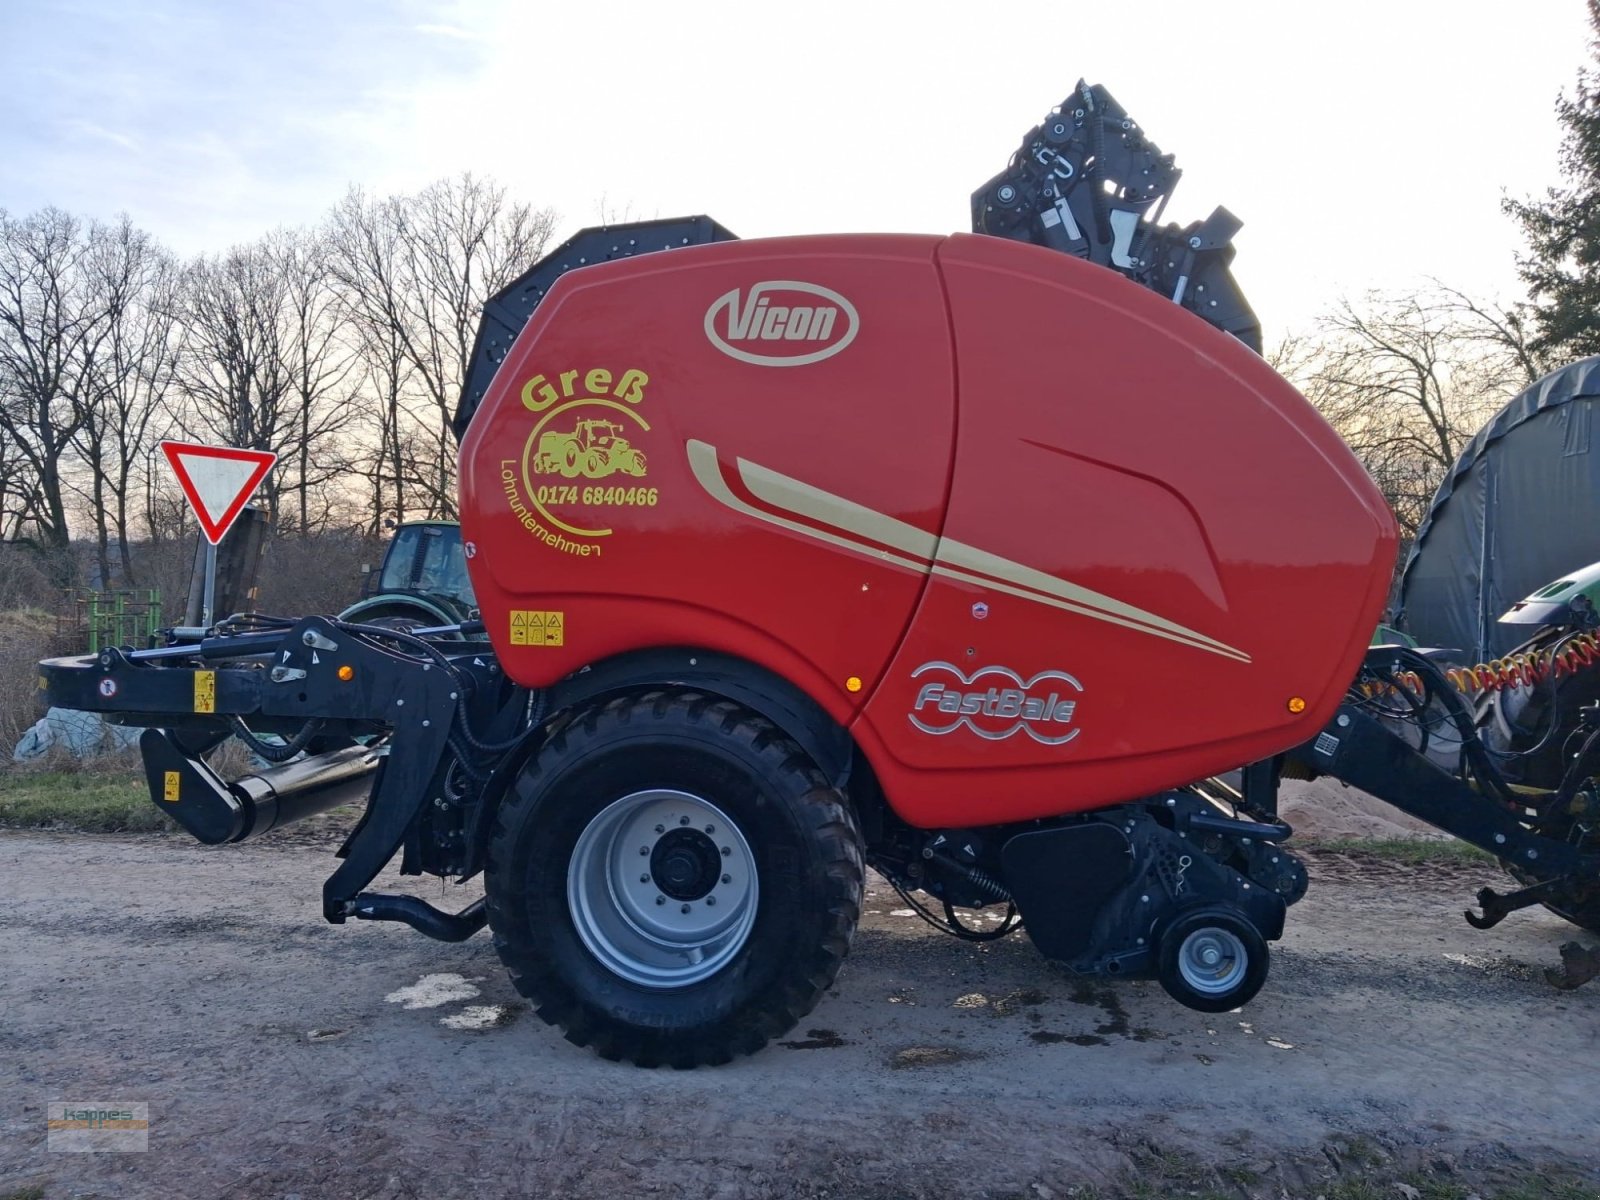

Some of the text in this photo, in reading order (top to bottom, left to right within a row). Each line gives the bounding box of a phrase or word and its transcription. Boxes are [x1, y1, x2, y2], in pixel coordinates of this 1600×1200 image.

[727, 288, 837, 340] Vicon
[521, 368, 648, 412] Greß
[501, 459, 601, 556] Lohnunternehmen
[537, 486, 658, 506] 0174 6840466
[915, 683, 1076, 723] FastBale
